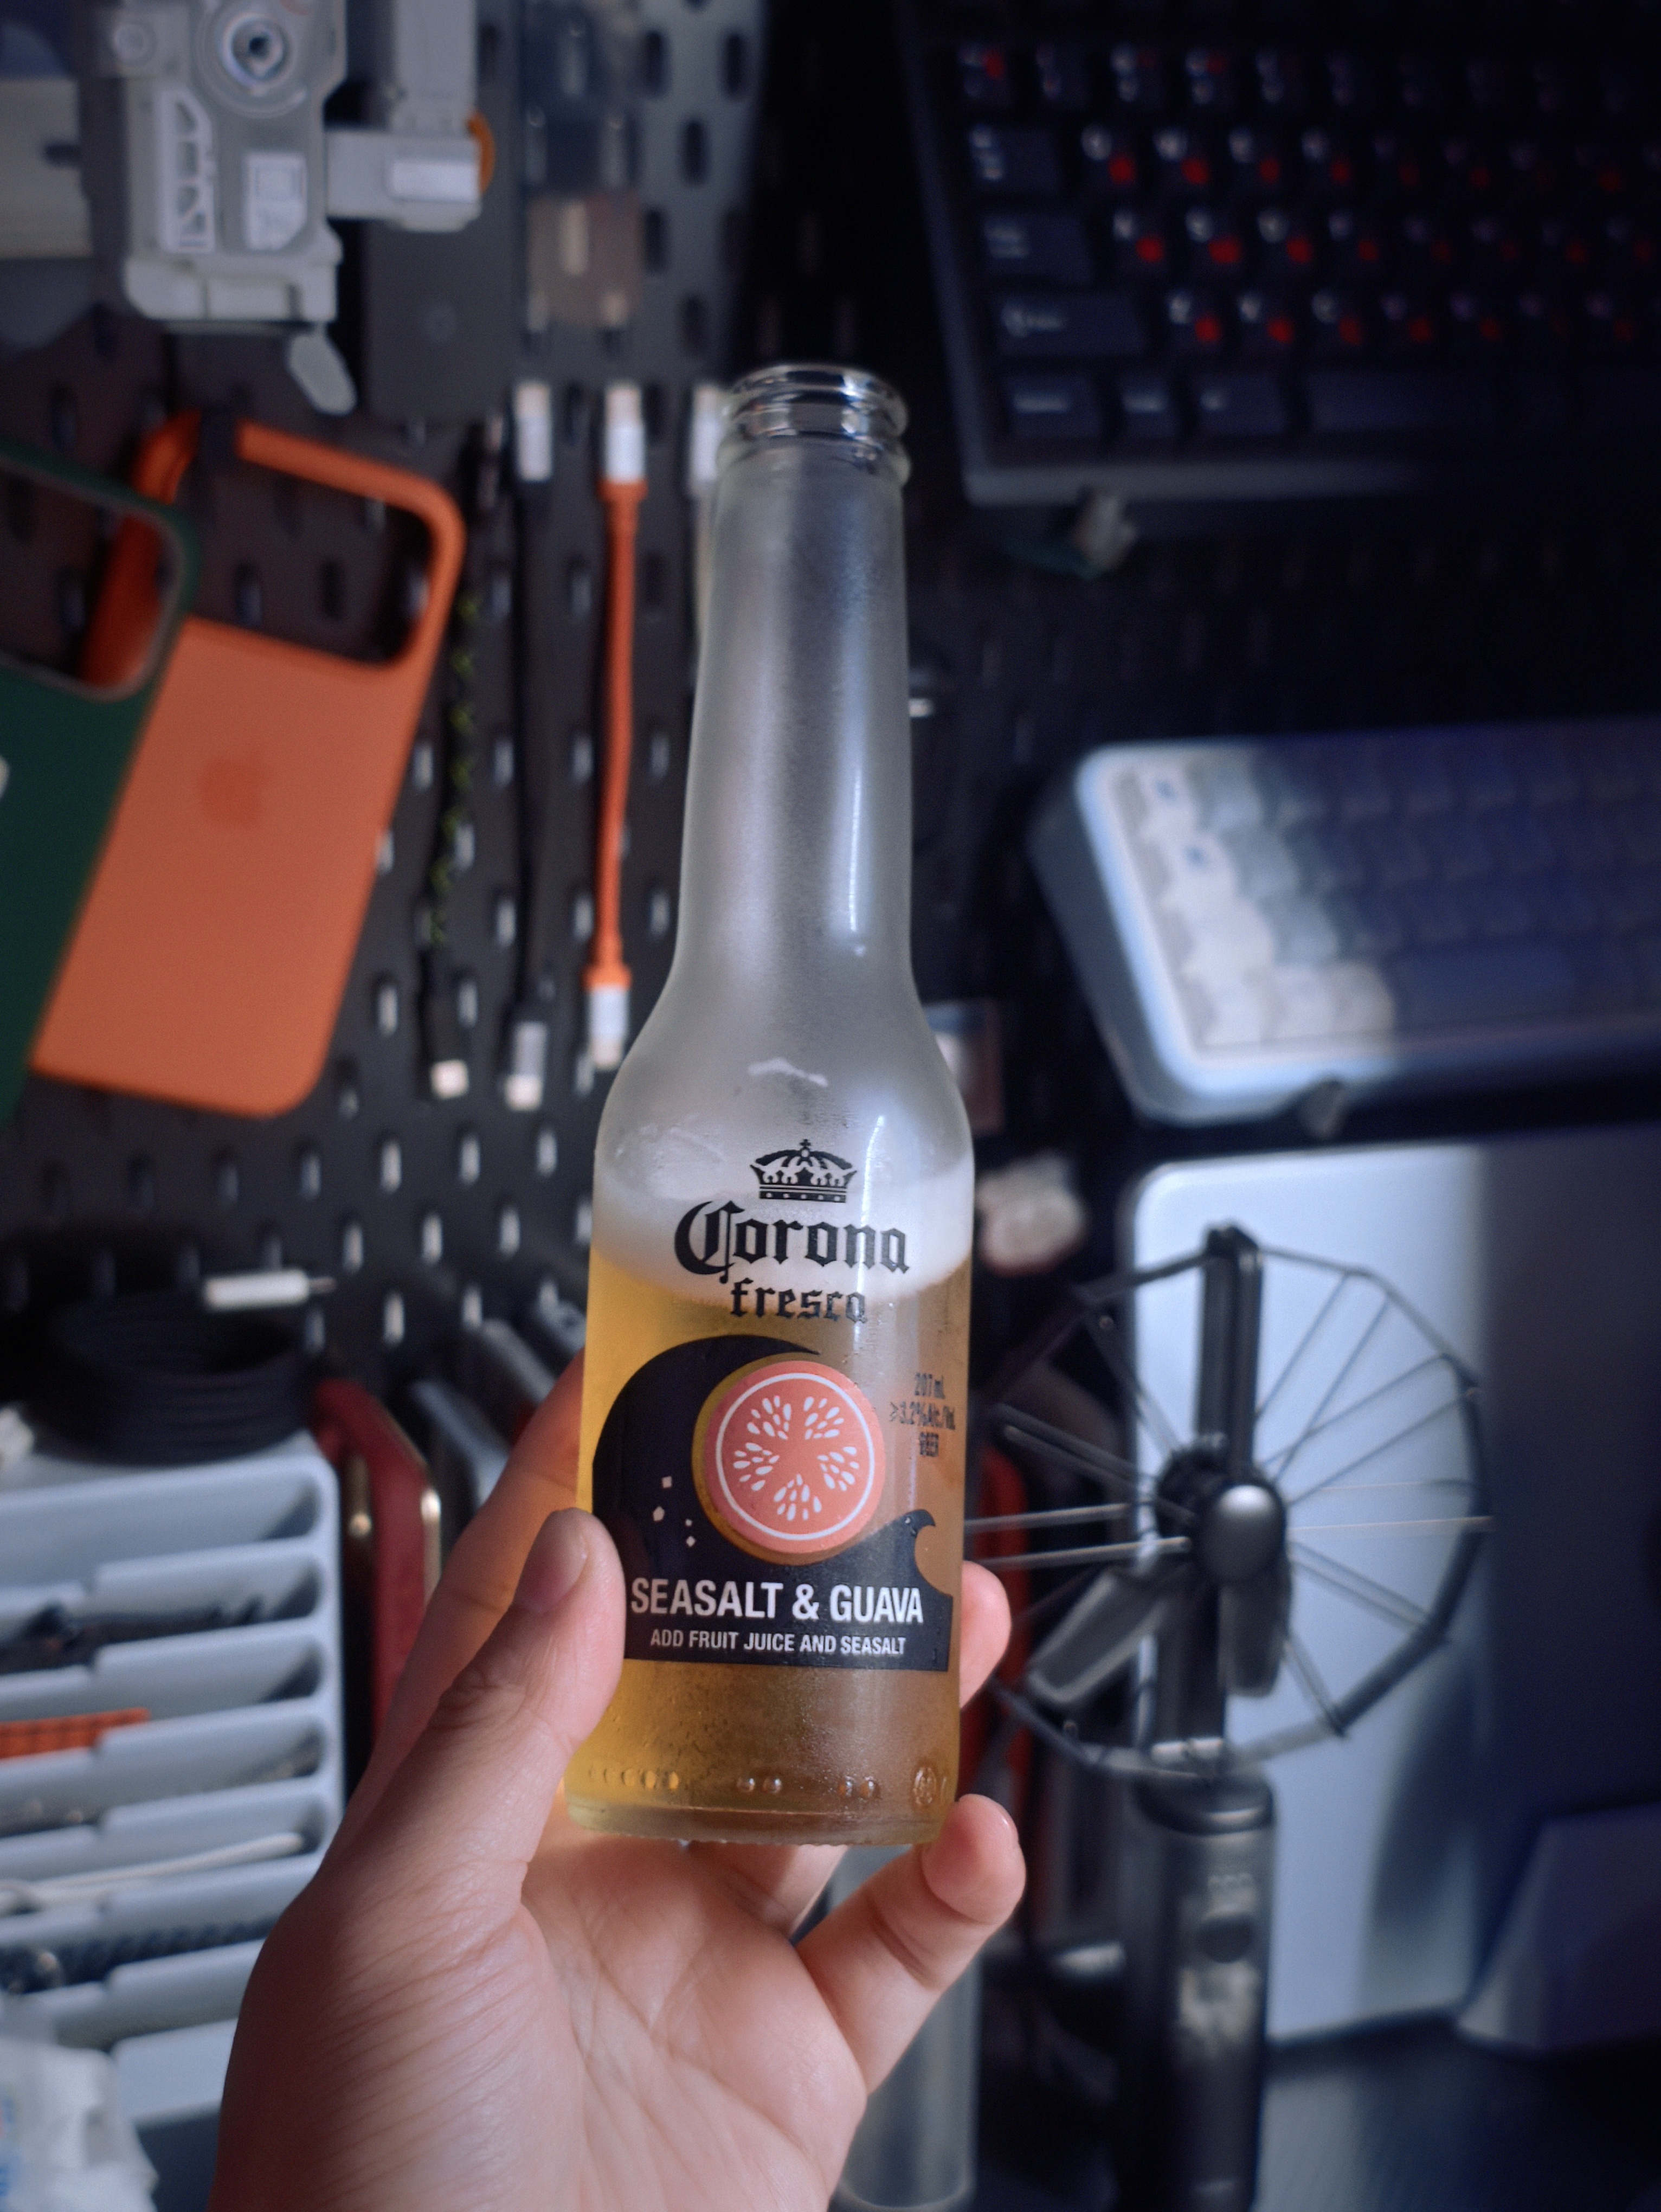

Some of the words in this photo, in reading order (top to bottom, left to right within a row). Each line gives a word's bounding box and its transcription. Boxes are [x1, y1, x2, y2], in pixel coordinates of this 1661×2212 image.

[674, 1200, 910, 1283] Corona
[631, 1577, 783, 1618] SEASALT
[792, 1584, 820, 1620] &
[829, 1584, 924, 1623] GUAVA
[651, 1629, 684, 1647] ADD
[688, 1630, 739, 1650] FRUIT
[743, 1632, 795, 1652] JUICE
[800, 1634, 837, 1653] AND
[840, 1635, 906, 1654] SEASALT
